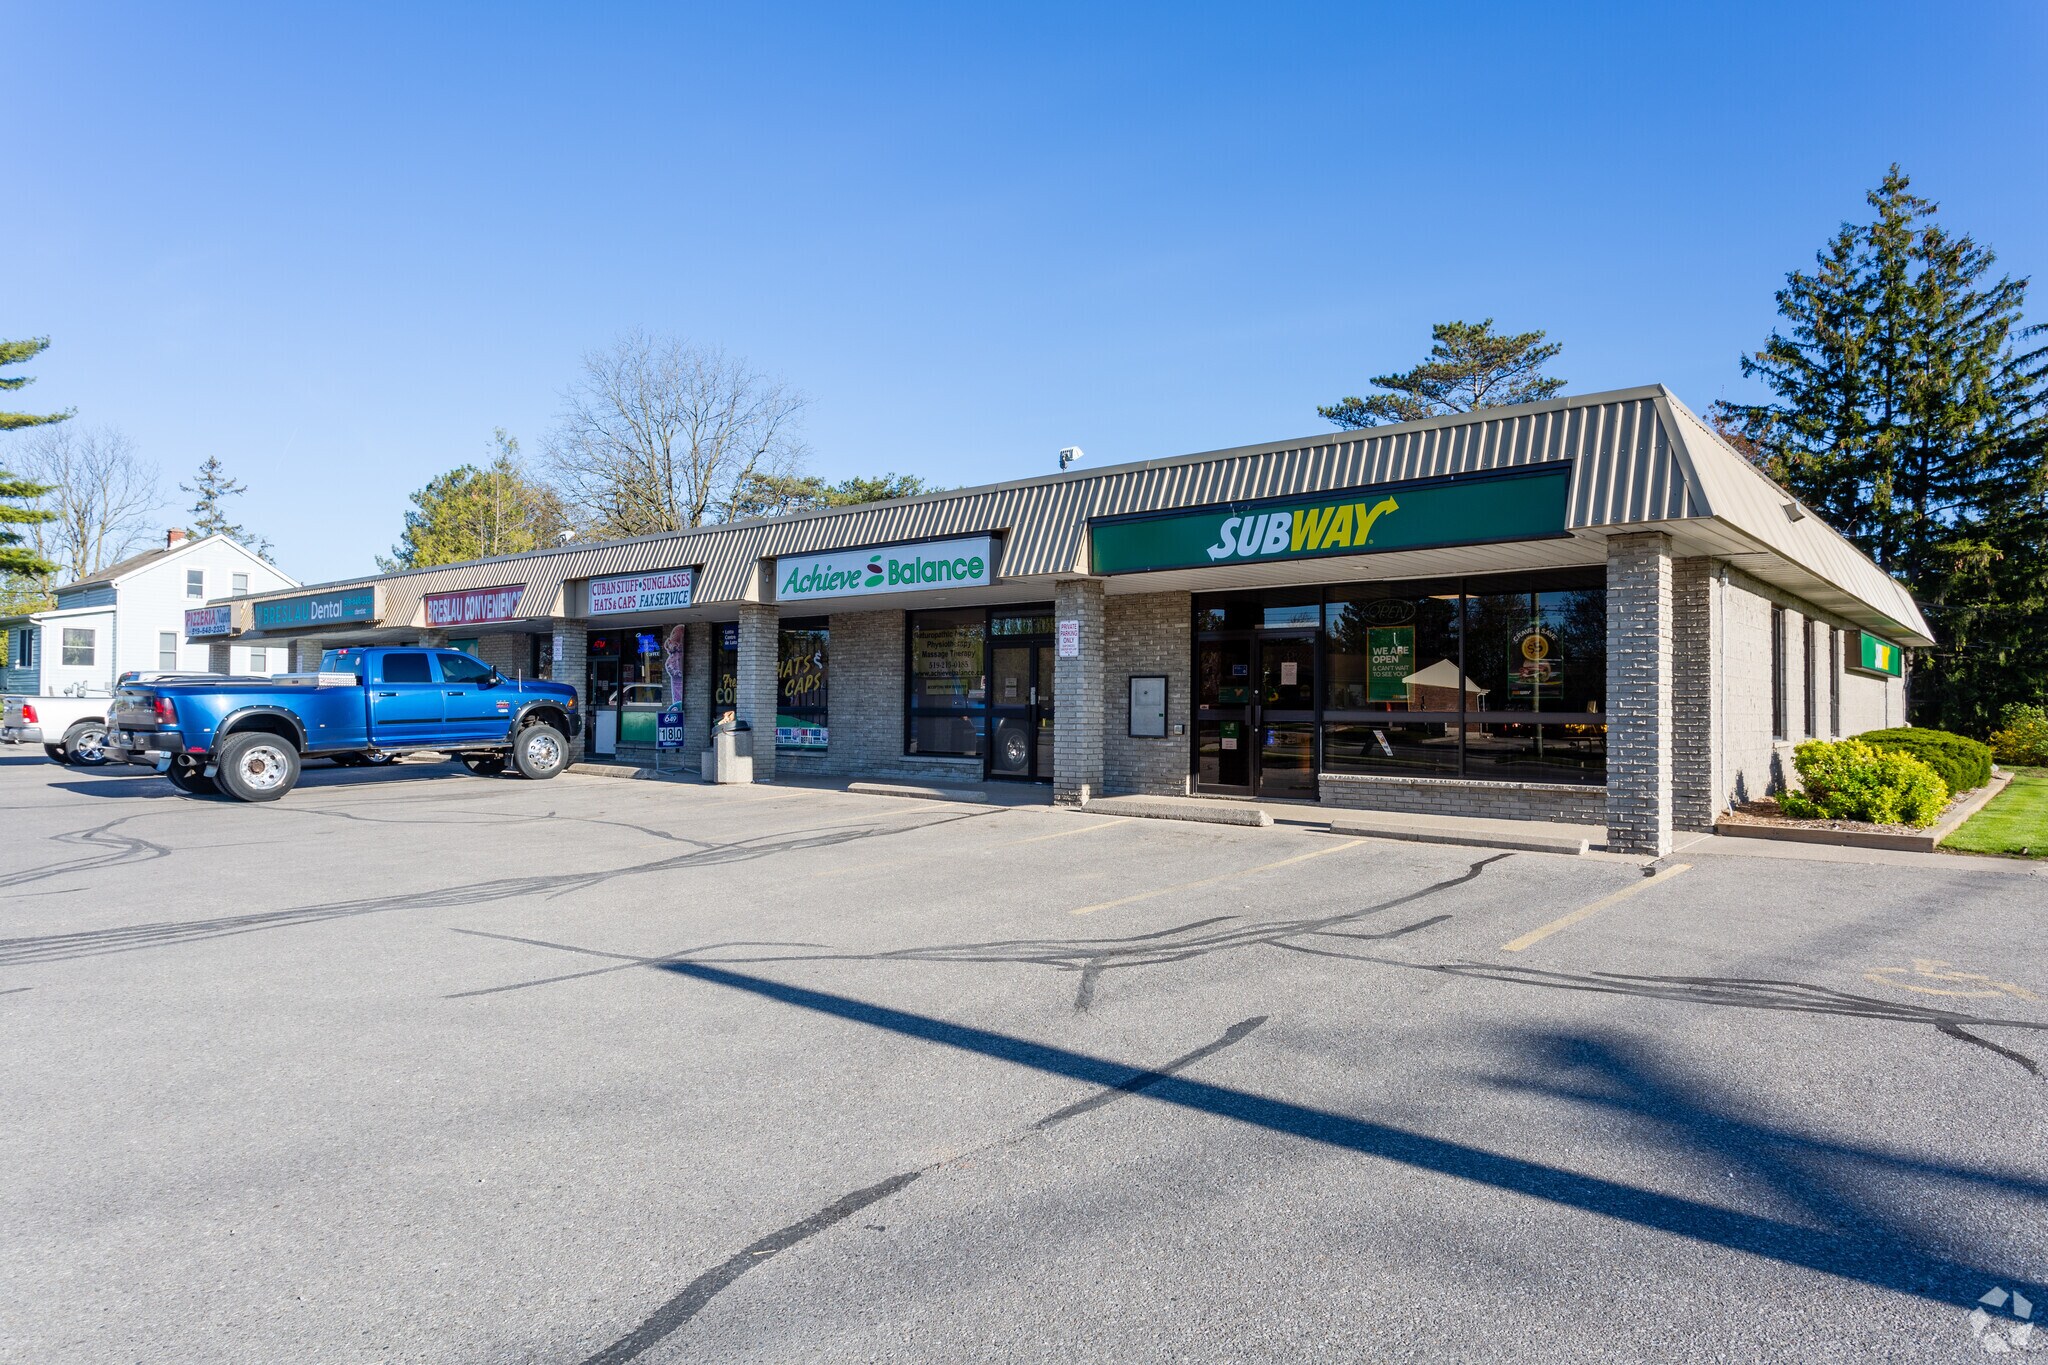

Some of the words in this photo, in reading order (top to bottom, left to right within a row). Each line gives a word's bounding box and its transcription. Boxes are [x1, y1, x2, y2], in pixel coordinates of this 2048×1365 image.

[1206, 496, 1399, 562] SUBWAY
[592, 582, 616, 596] CUBAN
[617, 579, 639, 593] STUFF
[642, 573, 690, 591] SUNGLASSES
[781, 563, 862, 594] Achieve
[888, 556, 984, 586] Balance
[263, 601, 309, 625] BRESLAU
[311, 599, 342, 620] Dental
[428, 598, 463, 623] BRESLAU
[594, 597, 612, 611] HATS
[618, 595, 636, 609] CAPS
[639, 593, 656, 607] FAX
[656, 590, 689, 606] SERVICE
[1368, 604, 1408, 619] OPEN
[1513, 627, 1534, 642] CRAVE
[1541, 628, 1557, 641] SAVE
[1372, 655, 1399, 664] OPEN
[1373, 647, 1388, 655] WE
[1390, 646, 1410, 655] ARE
[777, 655, 812, 678] HATS
[785, 672, 821, 696] CAPS
